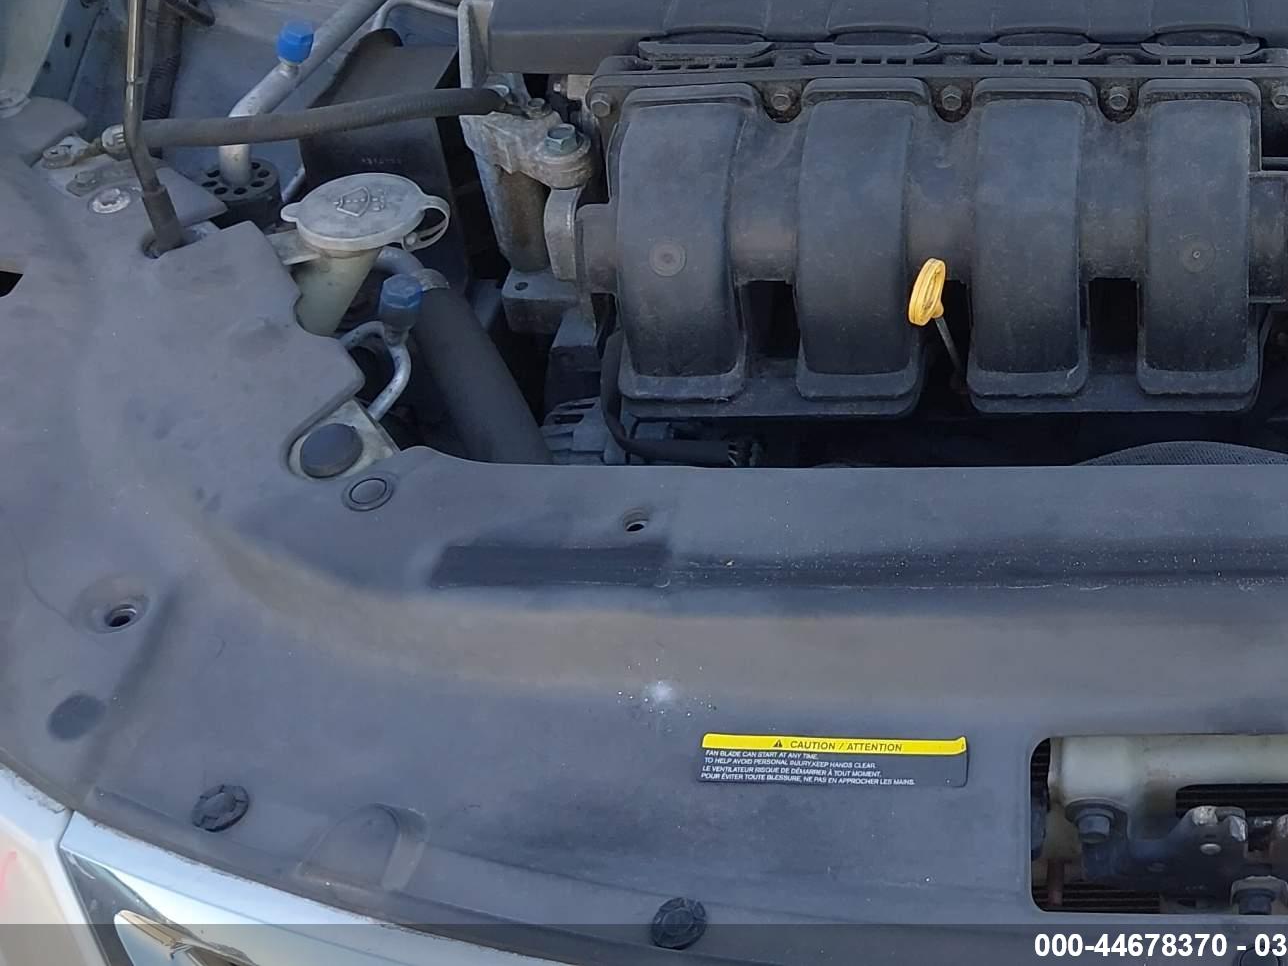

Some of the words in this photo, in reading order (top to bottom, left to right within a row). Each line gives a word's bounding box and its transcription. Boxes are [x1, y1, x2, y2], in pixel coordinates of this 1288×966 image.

[789, 740, 835, 751] CAUTION
[838, 741, 844, 751] /
[847, 741, 903, 752] ATTENTION
[755, 766, 779, 774] RISQUE
[838, 777, 879, 785] APPROCHER
